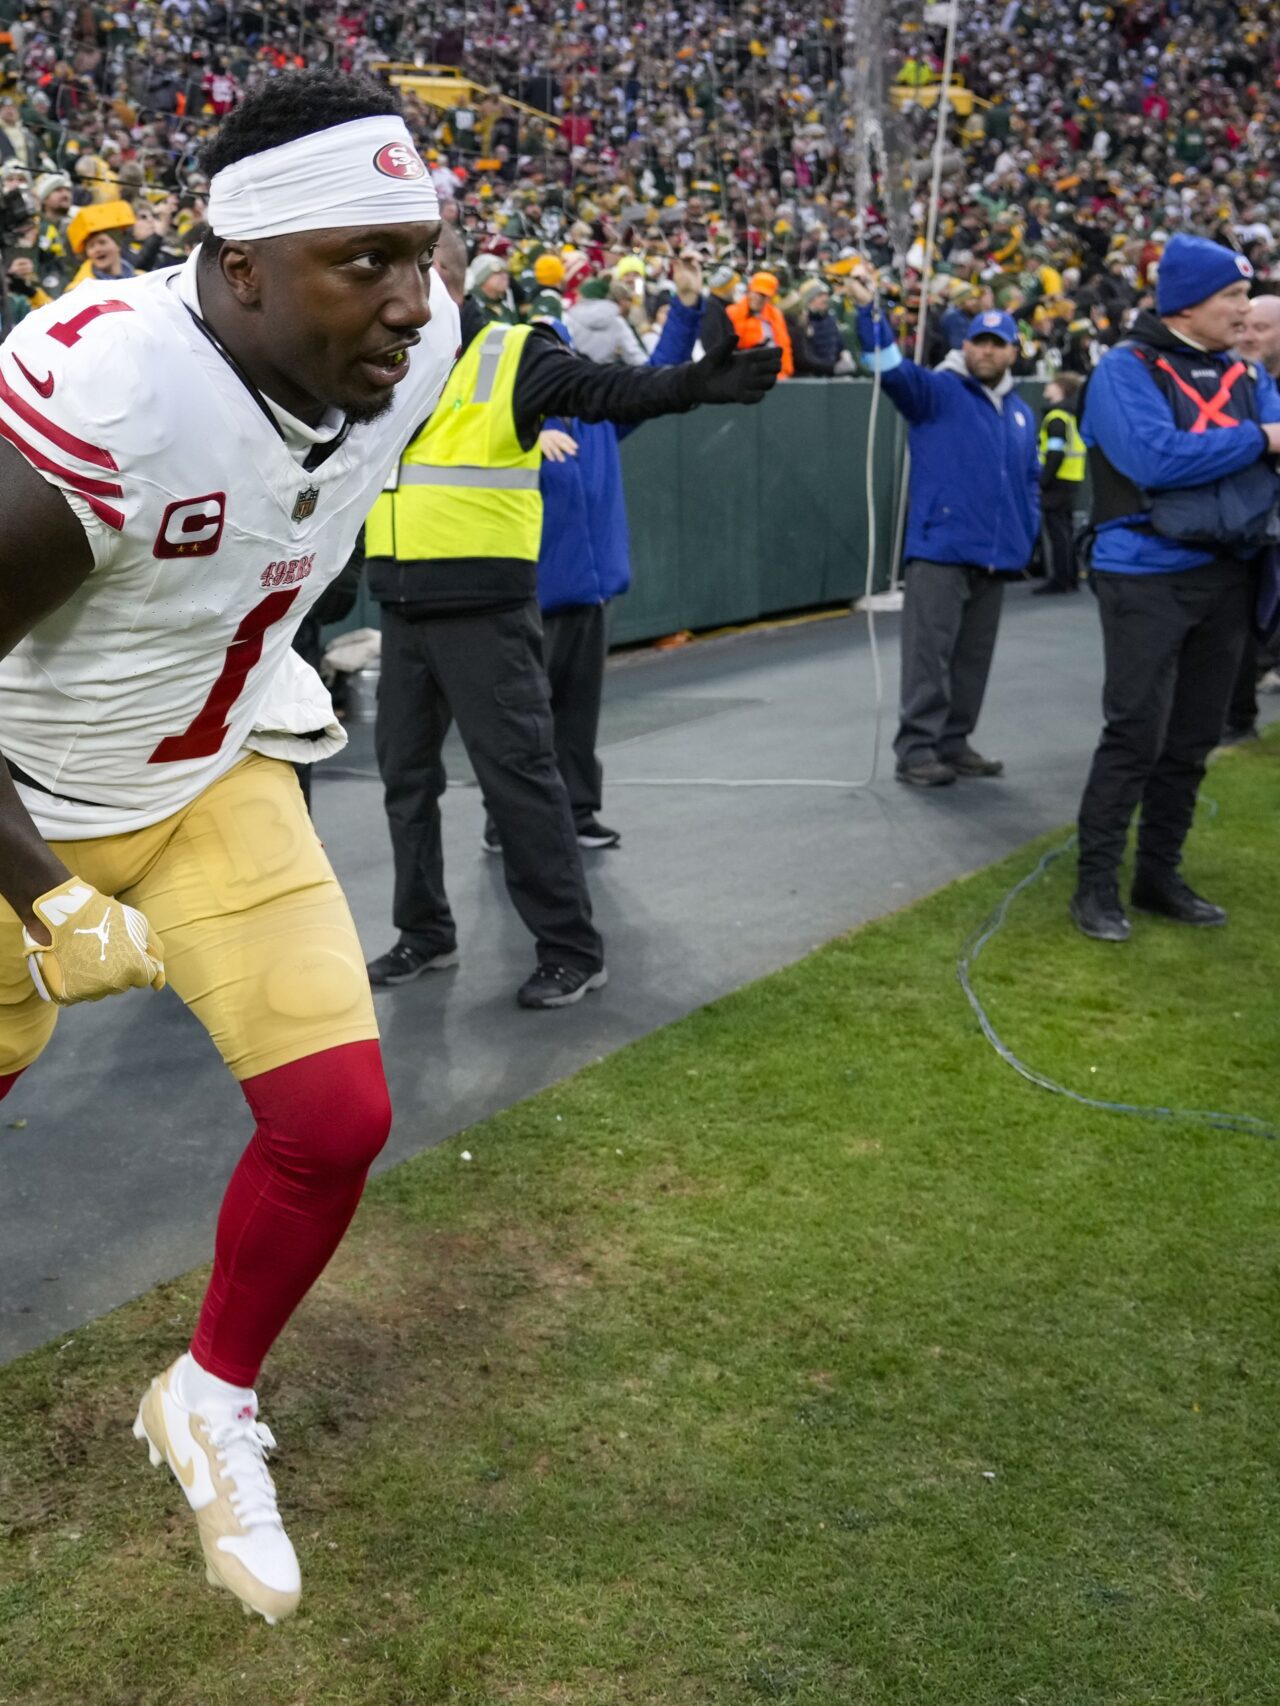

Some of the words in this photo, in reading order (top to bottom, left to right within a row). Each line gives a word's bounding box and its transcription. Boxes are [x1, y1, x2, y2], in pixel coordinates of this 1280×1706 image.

[46, 299, 136, 348] 1
[164, 499, 221, 545] C
[259, 552, 317, 587] 49ERS
[146, 585, 302, 764] 1
